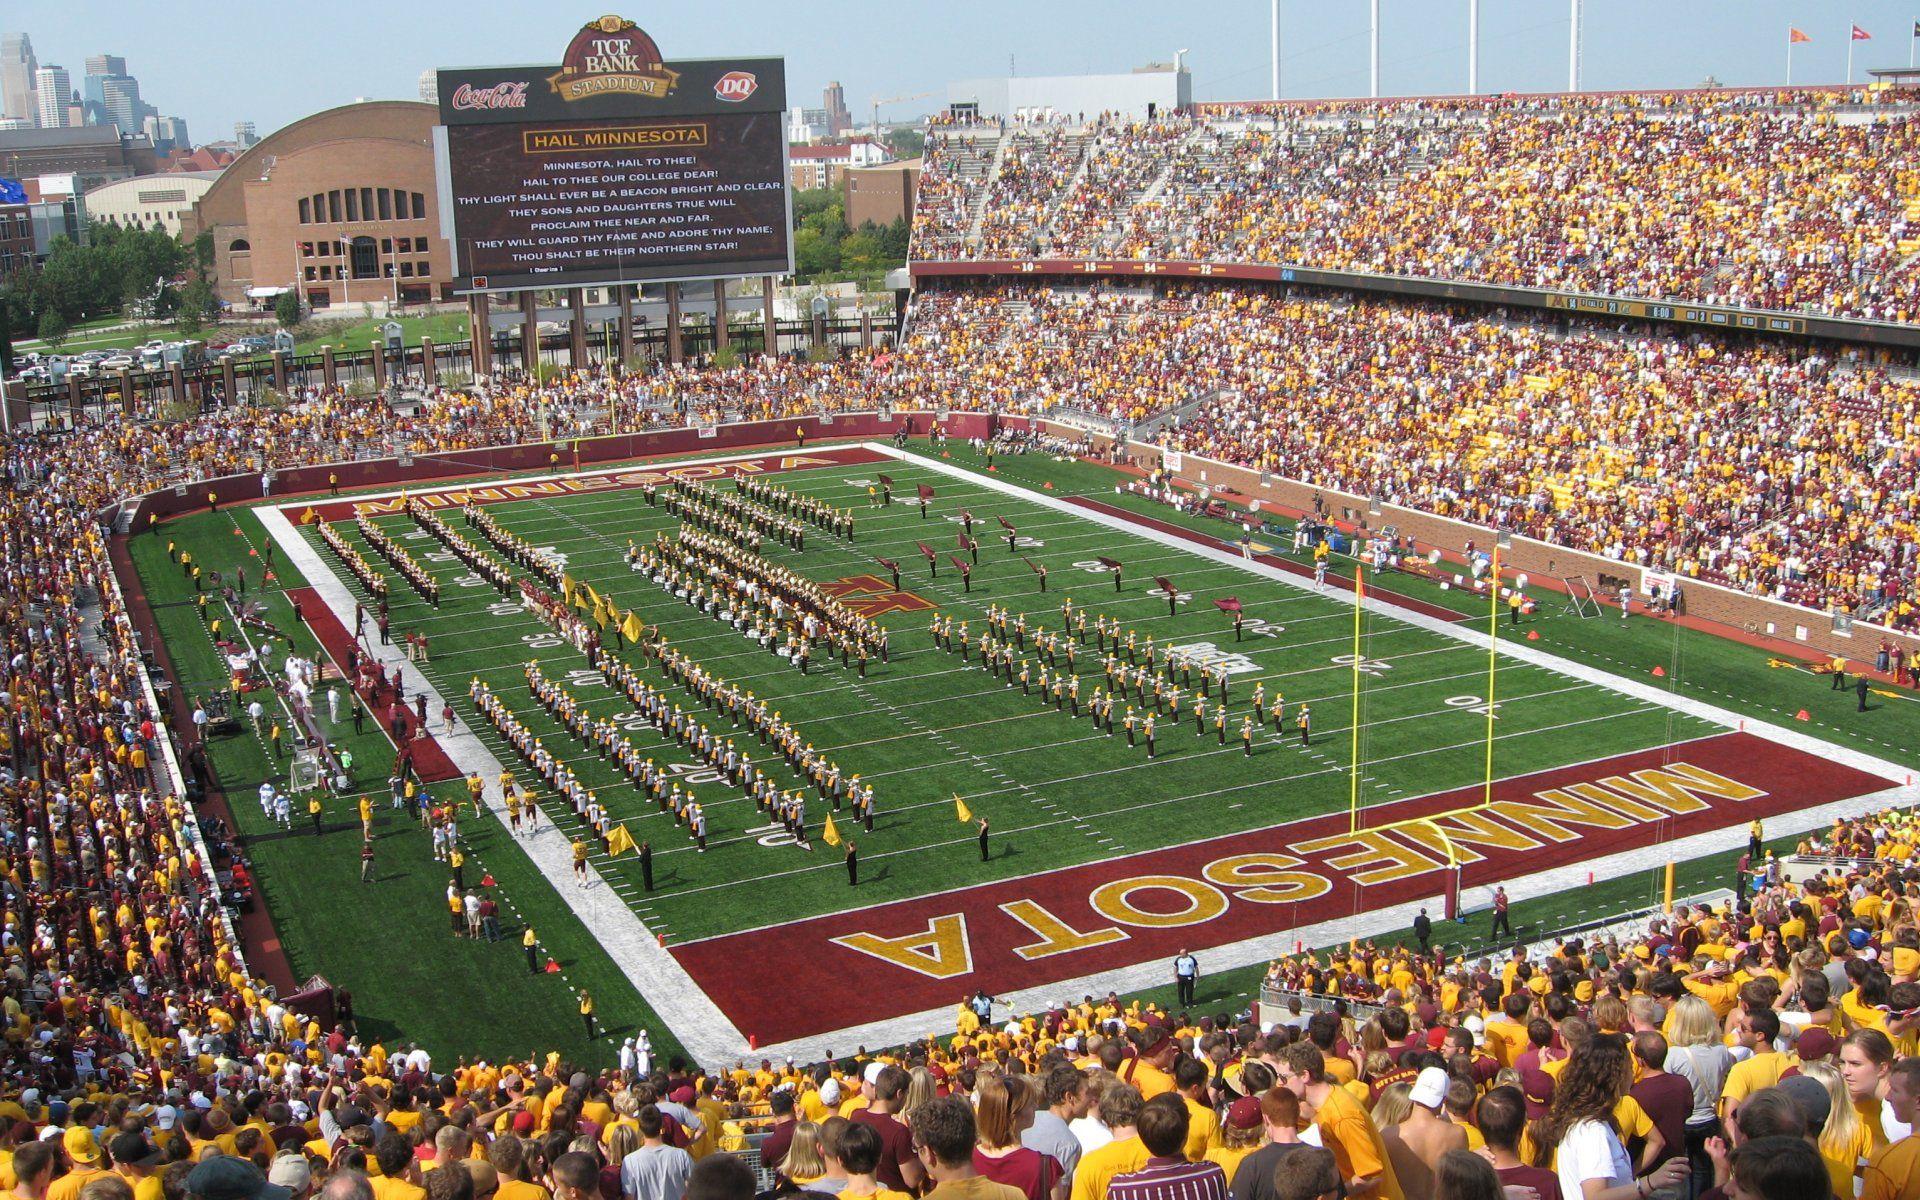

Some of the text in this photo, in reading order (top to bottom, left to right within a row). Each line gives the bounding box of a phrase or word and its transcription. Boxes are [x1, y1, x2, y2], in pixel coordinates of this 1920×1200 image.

[592, 39, 632, 56] TCF
[585, 55, 641, 73] BANK
[571, 77, 656, 96] STADIUM
[722, 78, 751, 95] DQ
[452, 82, 530, 110] Coca-Cola
[534, 129, 700, 148] HAIL MINNESOTA
[616, 158, 644, 168] HAIL
[646, 158, 662, 166] TO
[664, 156, 697, 166] THEE!
[523, 170, 719, 186] HAIL TO THEE OUR COLLEGE DEAR!
[458, 196, 481, 206] THY
[483, 194, 517, 204] LIGHT
[519, 193, 556, 202] SHALL
[560, 192, 588, 200] EVER
[592, 190, 606, 198] BE
[609, 190, 618, 198] A
[620, 187, 668, 197] BEACON
[670, 184, 714, 195] BRIGHT
[716, 184, 741, 192] AND
[508, 198, 736, 218] THEY SONS AND DAUGHTERS TRUE WILL
[530, 214, 714, 231] PROCLAIM THEE NEAR AND FAR.
[474, 240, 504, 250] THEY
[507, 238, 536, 247] WILL
[538, 236, 579, 246] GUARD
[582, 234, 603, 244] THY
[606, 232, 638, 242] FAME
[640, 230, 666, 240] AND
[668, 228, 708, 238] ADORE
[712, 228, 734, 236] THY
[512, 242, 738, 262] THOU SHALT BE THEIR NORTHERN STAR!
[1022, 262, 1034, 271] 10
[1085, 262, 1097, 272] 15
[1144, 263, 1156, 273] 54
[1200, 264, 1212, 275] 72
[353, 457, 839, 514] MINNESOTA
[521, 632, 564, 648] 50
[1444, 695, 1503, 716] 10
[828, 762, 1770, 979] MINNESOTA
